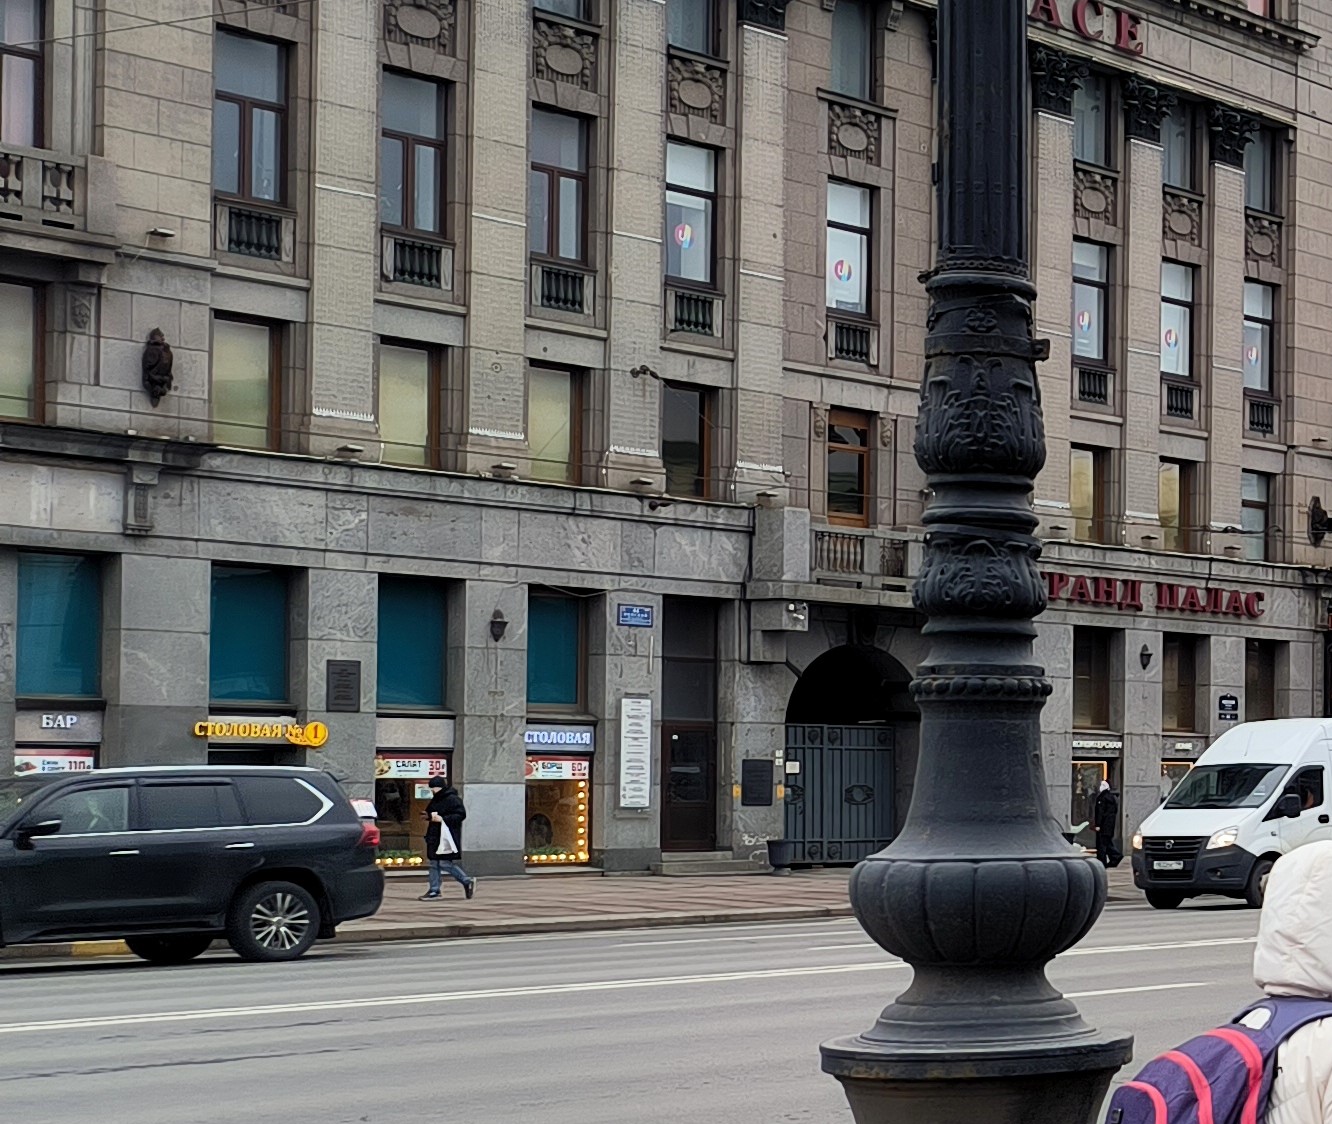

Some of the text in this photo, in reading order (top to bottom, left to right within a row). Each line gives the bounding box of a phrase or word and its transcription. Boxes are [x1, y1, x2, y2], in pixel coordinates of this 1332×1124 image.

[1040, 571, 1265, 617] РАНД ПАЛАС
[41, 714, 78, 729] БАР
[194, 720, 282, 738] СТОЛОВАЯ
[524, 731, 591, 744] СТОЛОВАЯ
[395, 760, 421, 768] САЛАТ
